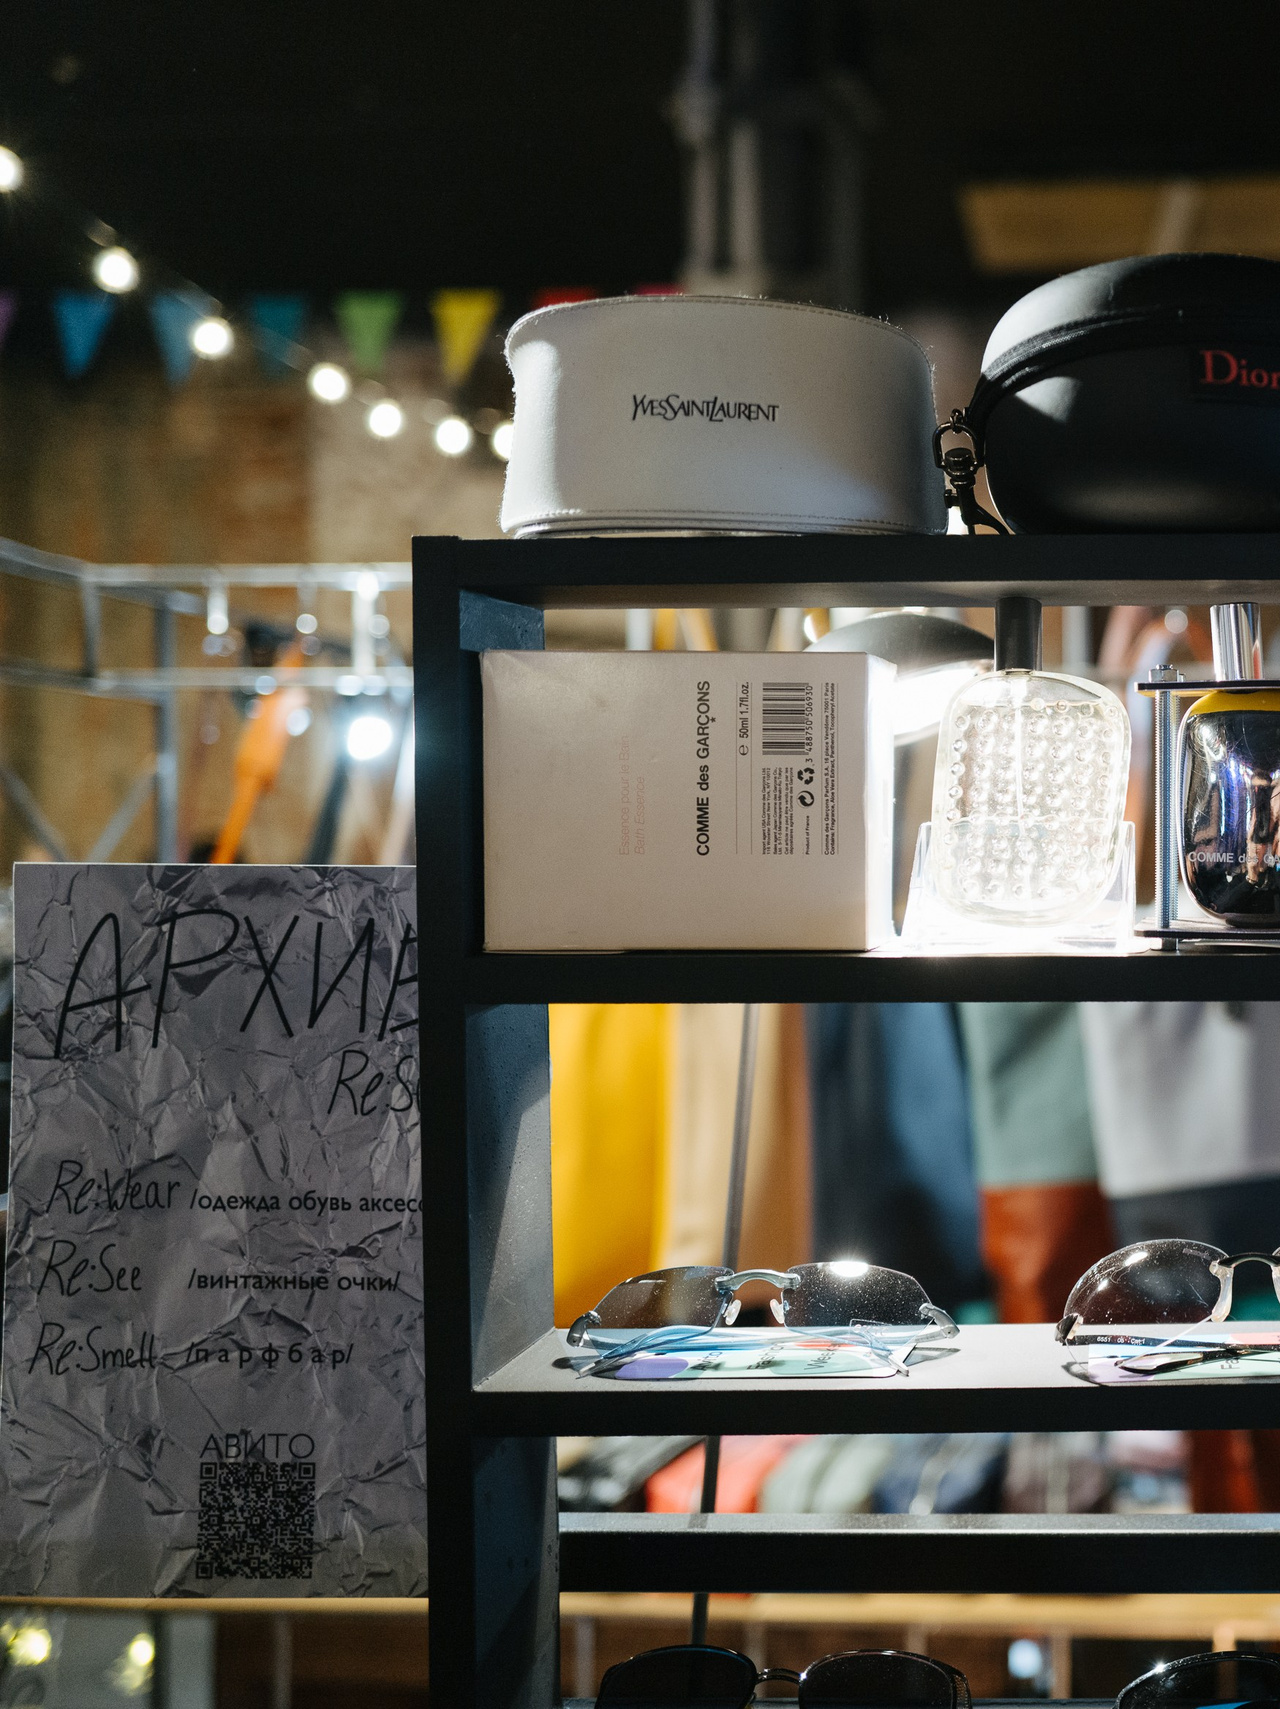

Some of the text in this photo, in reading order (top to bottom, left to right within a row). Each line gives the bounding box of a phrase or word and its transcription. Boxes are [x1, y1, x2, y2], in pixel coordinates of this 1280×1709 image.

[739, 682, 749, 715] 1.7fl.oz.
[739, 718, 749, 739] 50ml
[619, 765, 631, 774] le
[697, 681, 716, 856] COMME des GARÇONS
[619, 778, 631, 803] pour
[619, 808, 631, 855] Essence
[634, 777, 645, 854] Bath Essence
[1188, 851, 1233, 863] COMME
[328, 1048, 421, 1117] Re:S
[46, 1160, 181, 1216] Re:Wear
[190, 1188, 281, 1214] /одежда
[288, 1190, 352, 1217] обувь
[37, 1240, 142, 1297] Re:See
[188, 1268, 400, 1292] /винтажные очки/
[28, 1322, 158, 1376] Re:Smell
[200, 1433, 315, 1459] АВИТО
